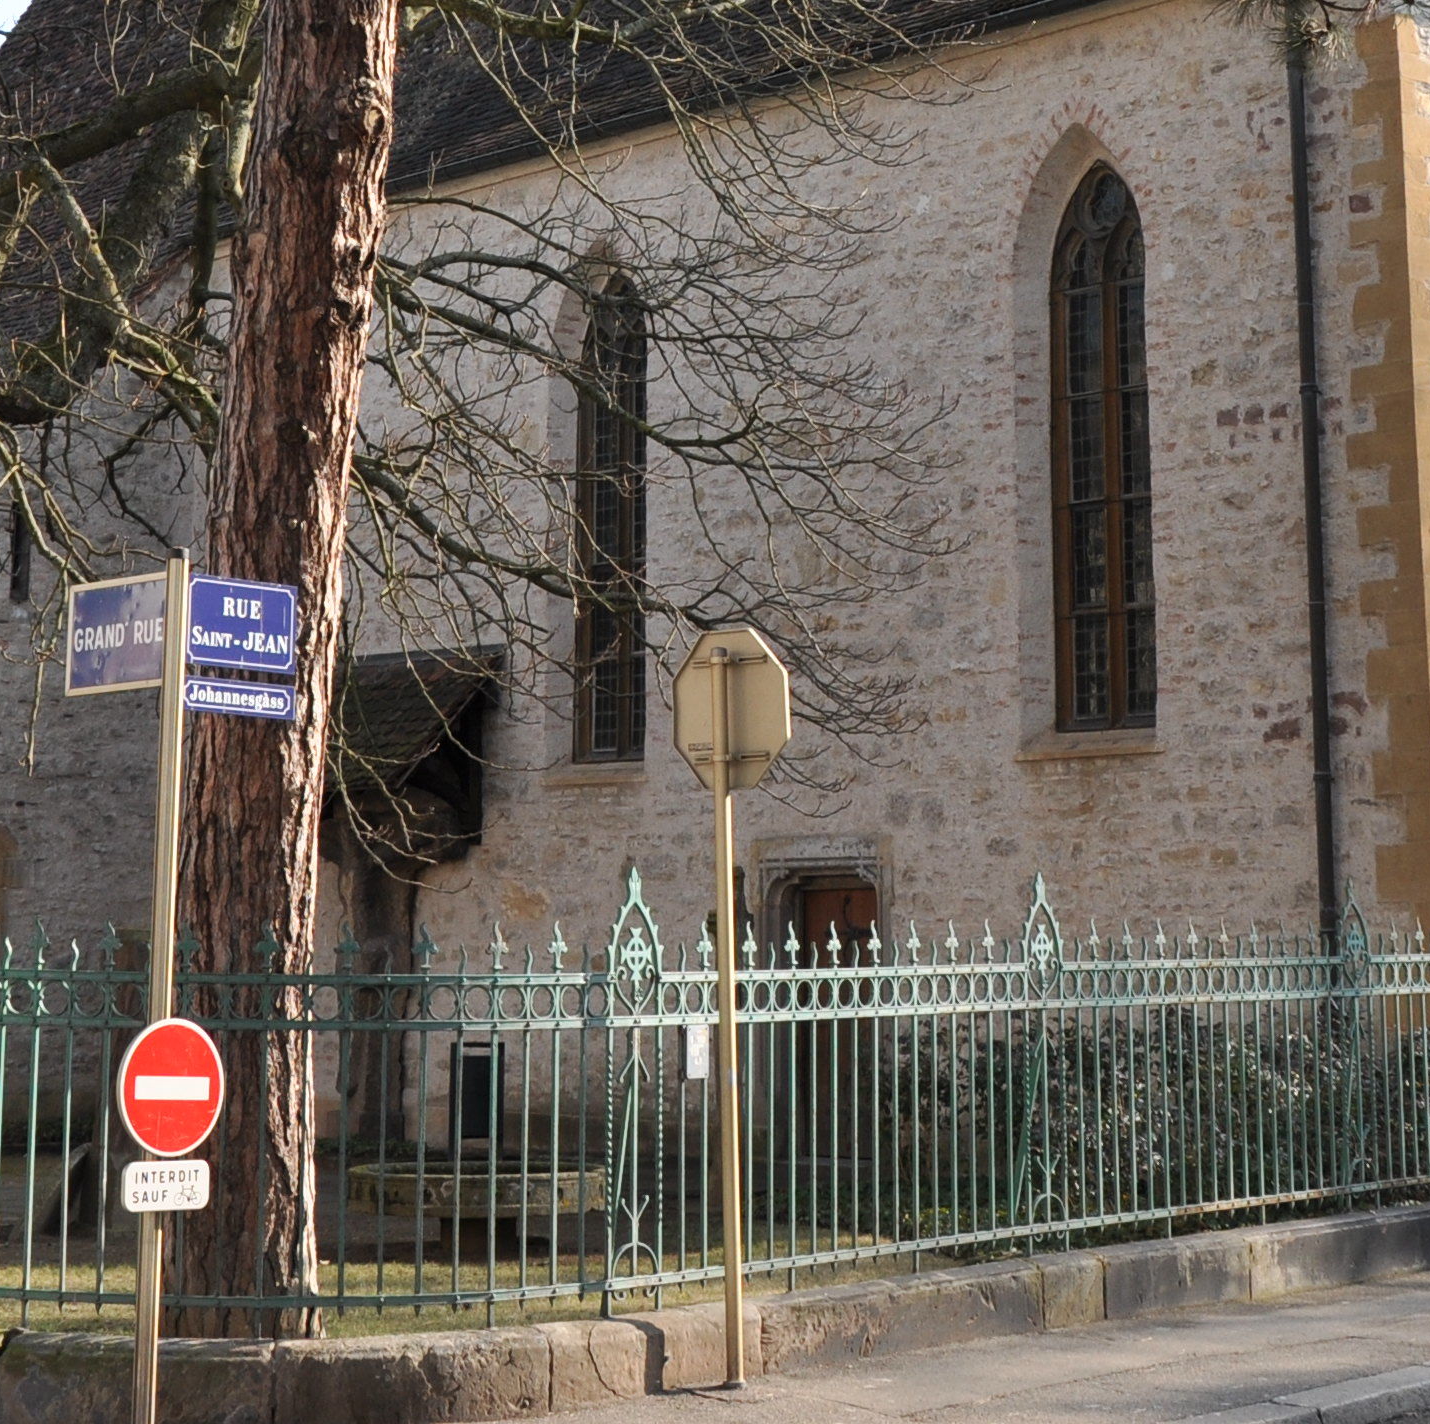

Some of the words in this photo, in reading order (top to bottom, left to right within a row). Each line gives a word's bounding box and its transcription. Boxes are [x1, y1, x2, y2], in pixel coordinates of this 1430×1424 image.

[222, 596, 262, 620] RUE
[133, 617, 164, 645] RUE
[189, 684, 285, 711] Johannesgàss
[135, 1169, 199, 1184] INTERDIT
[132, 1190, 168, 1203] SAUF
